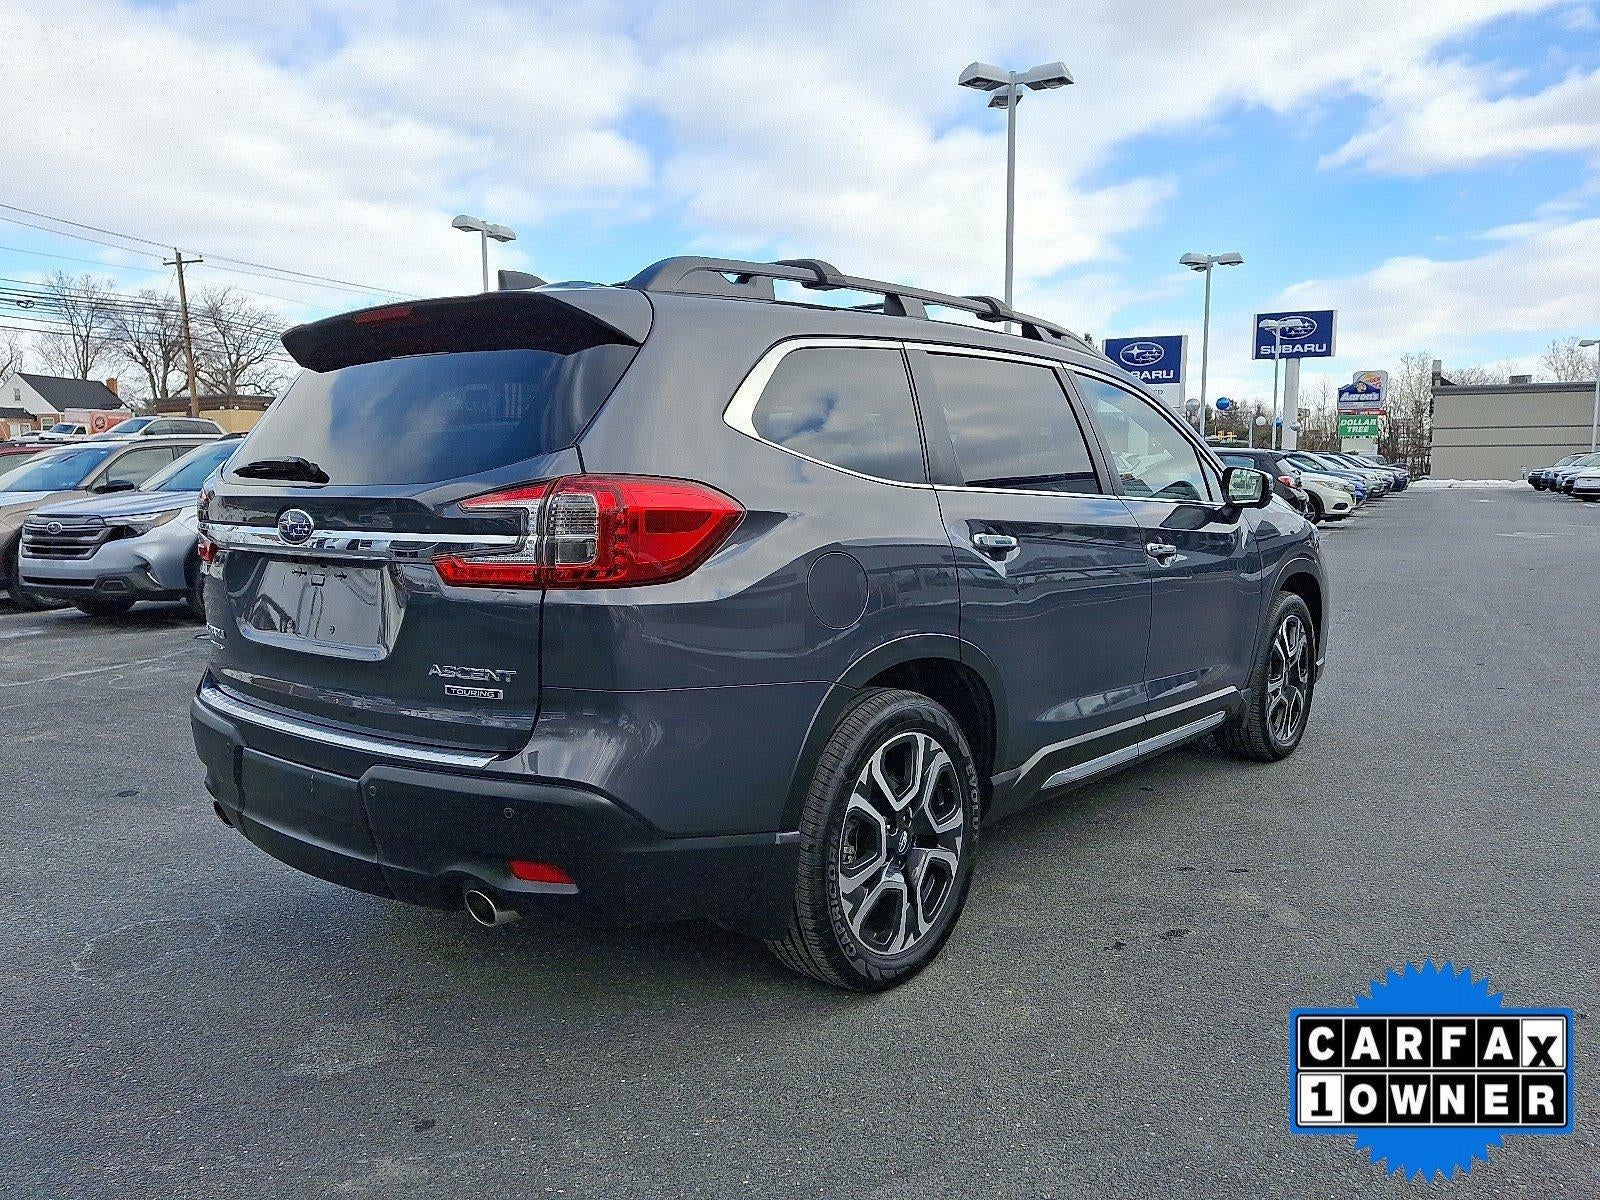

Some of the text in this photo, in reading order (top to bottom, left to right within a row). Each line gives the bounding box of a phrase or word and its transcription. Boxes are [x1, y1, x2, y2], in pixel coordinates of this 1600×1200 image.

[1260, 343, 1327, 355] SUBARU
[1131, 370, 1174, 380] BARU
[1340, 391, 1380, 401] Aaron's
[428, 663, 517, 682] ASCENT
[450, 687, 495, 698] TOURING
